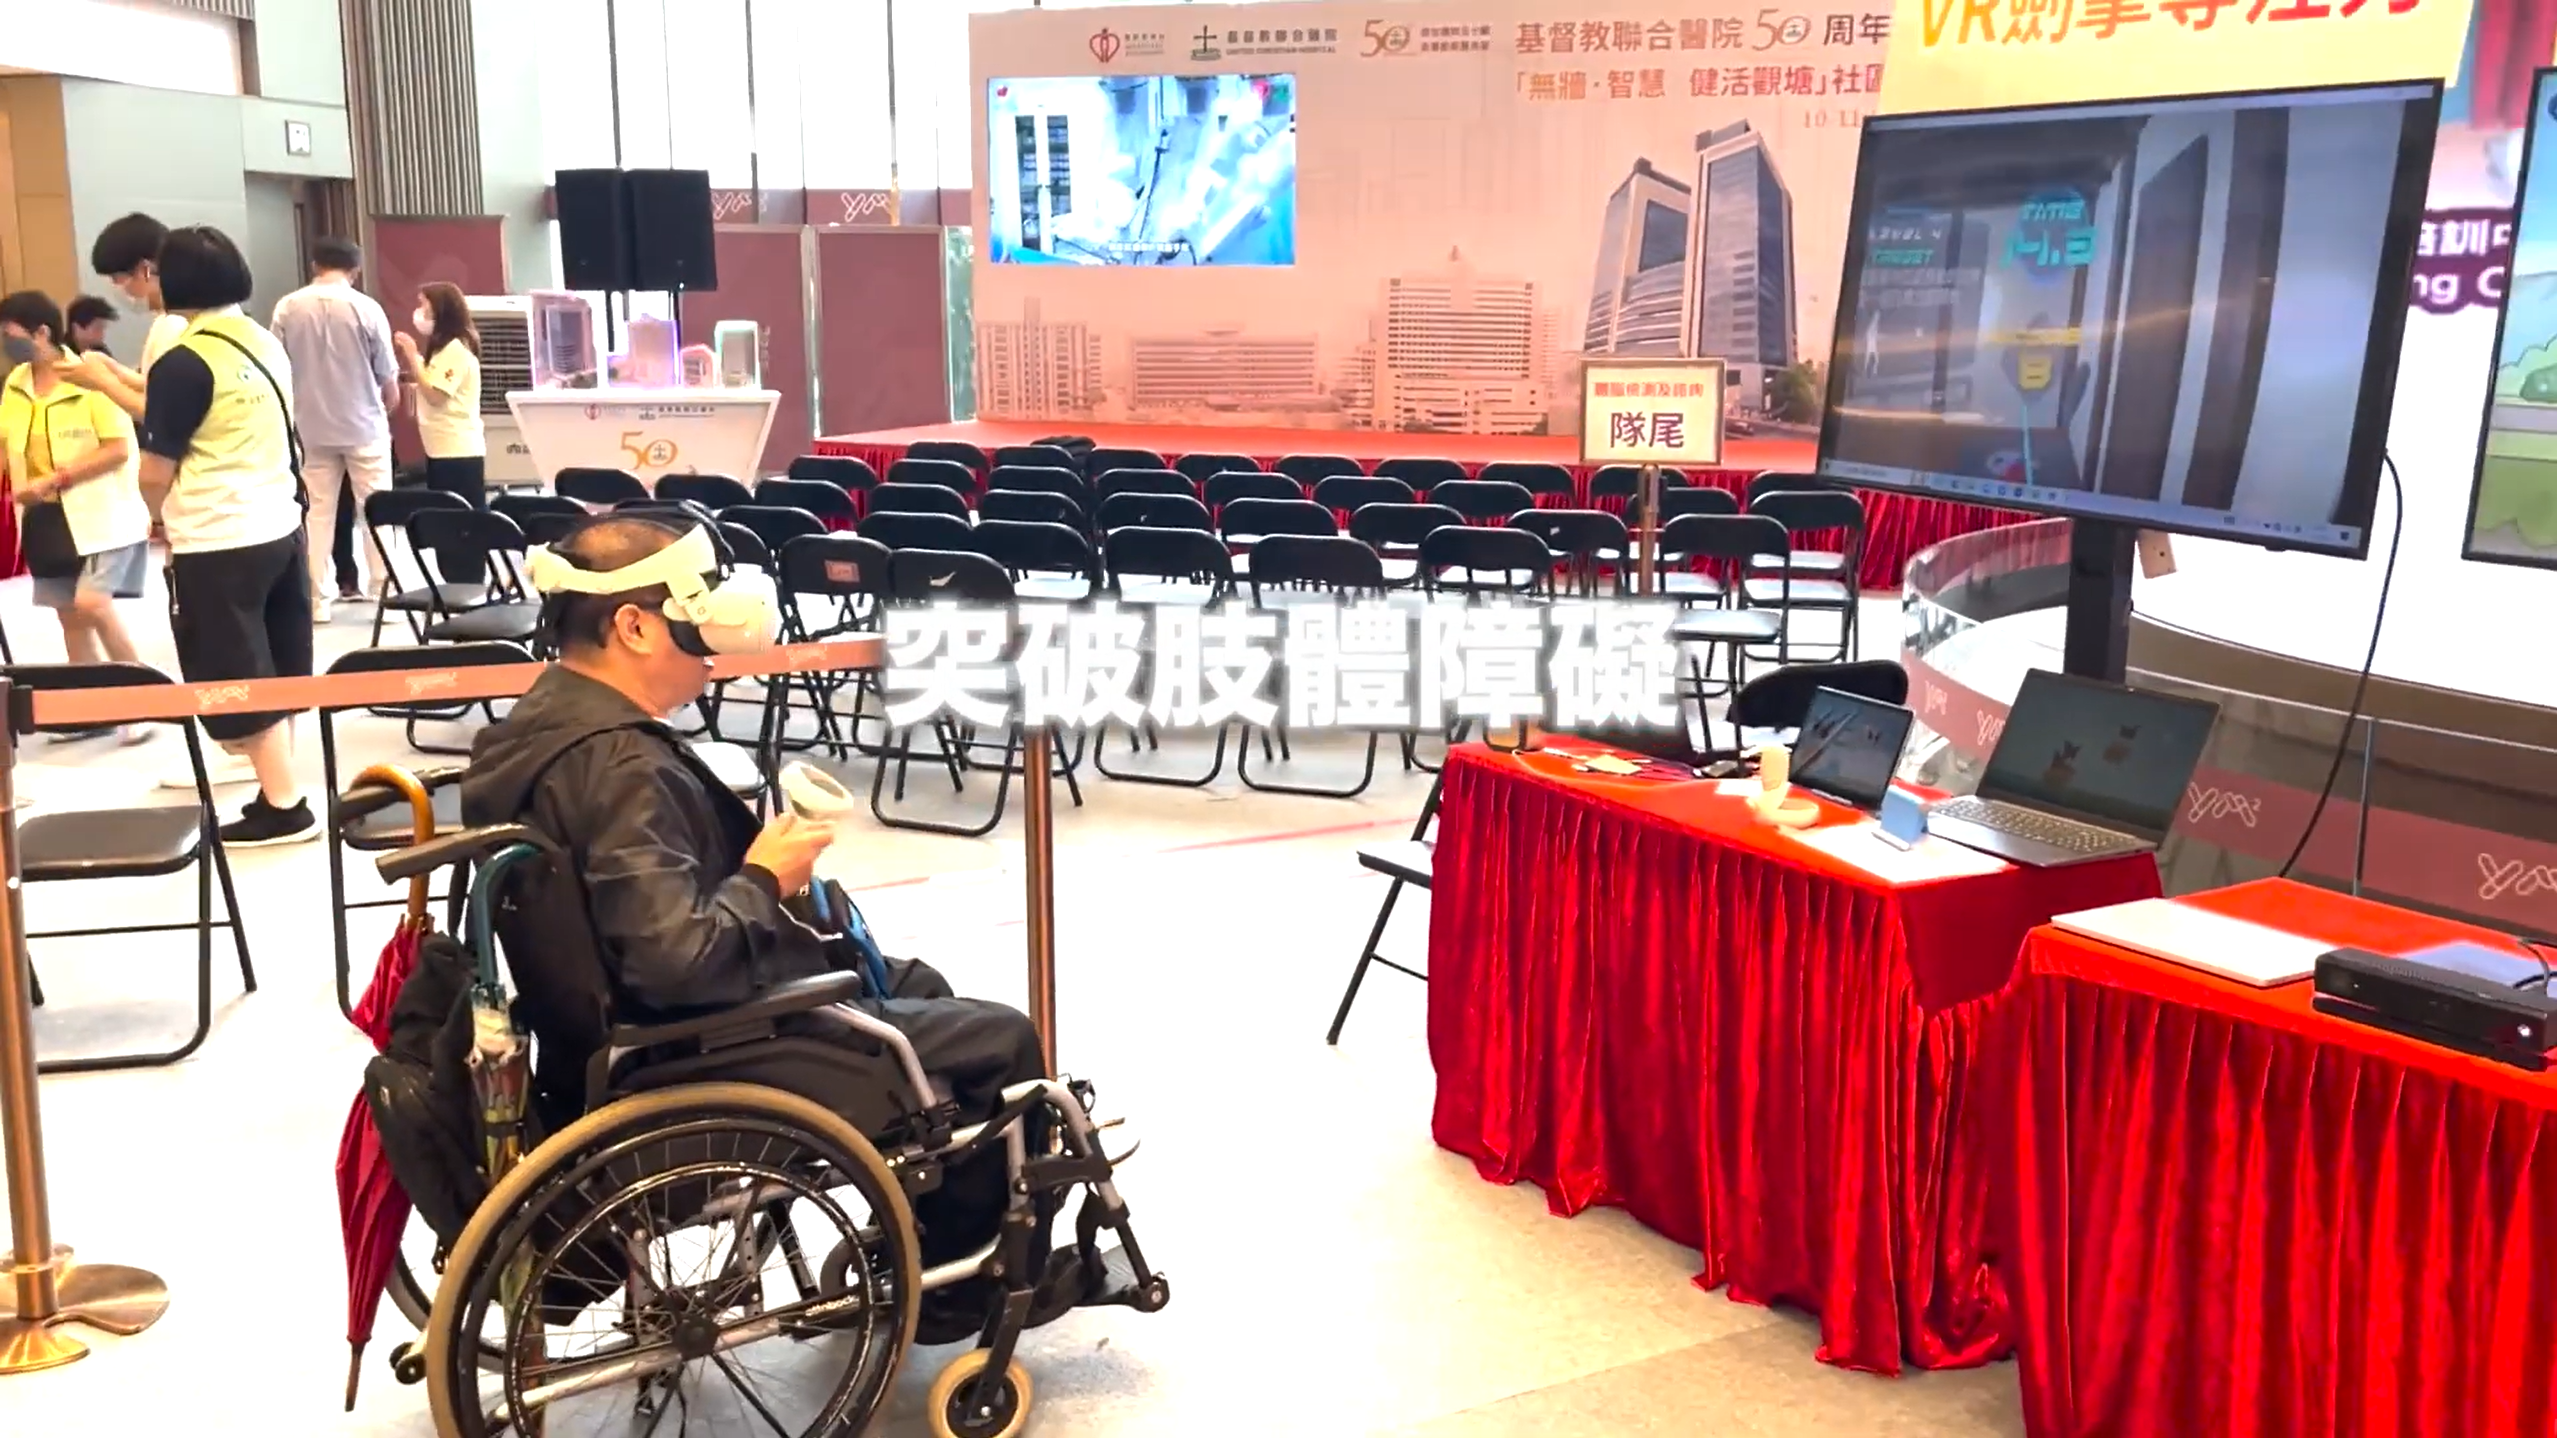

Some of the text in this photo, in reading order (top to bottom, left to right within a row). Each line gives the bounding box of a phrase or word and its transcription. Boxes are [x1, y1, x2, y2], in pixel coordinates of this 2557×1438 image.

[1515, 17, 1744, 54] 基督教聯合醫院
[1752, 8, 1812, 51] 50
[1824, 13, 1892, 47] 周年
[1610, 411, 1685, 449] 隊尾
